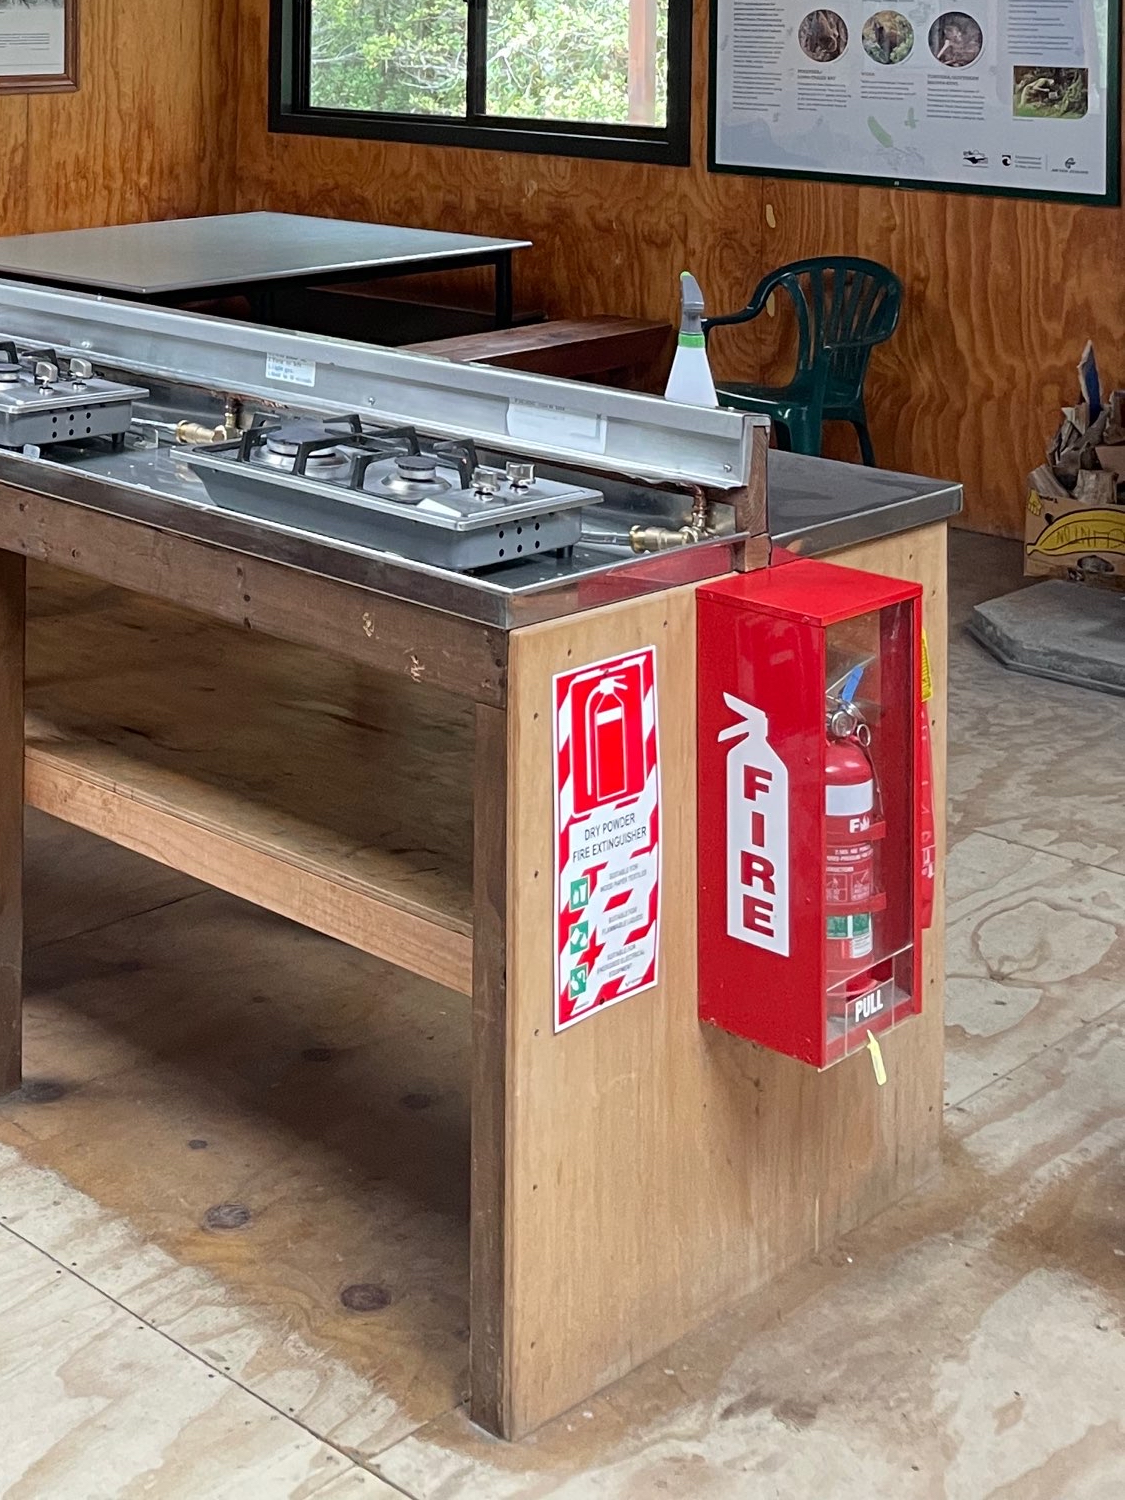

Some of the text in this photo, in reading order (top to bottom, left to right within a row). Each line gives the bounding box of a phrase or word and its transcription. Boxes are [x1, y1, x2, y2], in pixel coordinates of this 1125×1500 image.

[584, 812, 635, 841] DRY POWDER
[573, 826, 647, 863] FIRE EXTINGUISHER
[741, 764, 776, 938] FIRE
[855, 989, 884, 1023] PULL
